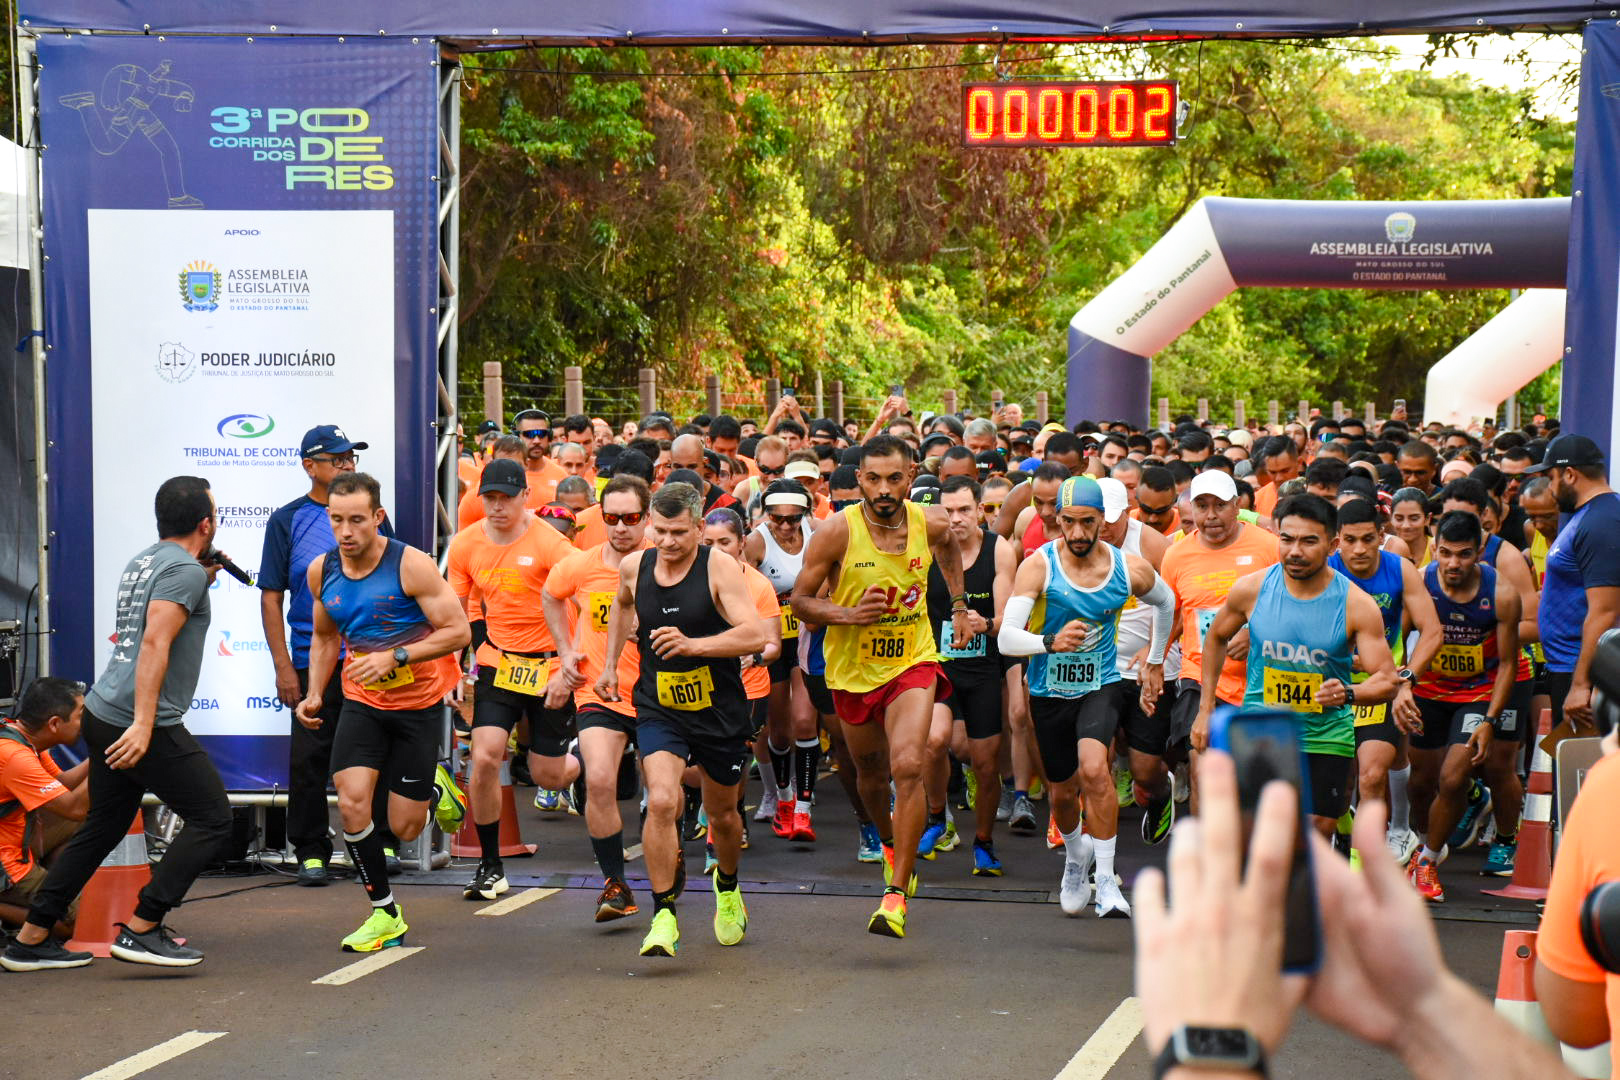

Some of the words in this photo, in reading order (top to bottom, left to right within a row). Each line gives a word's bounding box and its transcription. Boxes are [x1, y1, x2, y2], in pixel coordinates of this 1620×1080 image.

[268, 108, 369, 132] PO
[209, 137, 295, 148] CORRIDA
[300, 137, 384, 161] DE
[254, 151, 295, 161] DOS
[286, 165, 394, 190] RES
[1310, 242, 1398, 255] ASSEMBLEIA
[1402, 242, 1493, 255] LEGISLATIVA
[228, 269, 308, 280] ASSEMBLEIA
[1353, 272, 1359, 280] O
[1360, 272, 1391, 281] ESTADO
[1393, 272, 1403, 281] DO
[1405, 272, 1447, 281] PANTANAL
[228, 282, 310, 293] LEGISLATIVA
[1116, 326, 1125, 335] O
[1124, 299, 1157, 328] Estado
[1157, 287, 1170, 299] do
[1169, 249, 1212, 288] Pantanal
[201, 353, 250, 366] PODER
[254, 349, 336, 366] JUDICIÁRIO
[183, 447, 240, 457] TRIBUNAL
[244, 447, 259, 457] DE
[262, 447, 301, 457] CONTA
[216, 506, 280, 516] EFENSORI
[225, 519, 252, 528] MATO
[785, 614, 798, 631] 16
[871, 638, 904, 658] 1388
[1262, 640, 1328, 667] ADAC
[1440, 654, 1475, 672] 2068
[509, 666, 538, 687] 1974
[1056, 663, 1094, 682] 11639
[669, 681, 702, 704] 1607
[1276, 683, 1311, 704] 1344
[190, 699, 220, 710] OBA
[246, 696, 287, 712] msg
